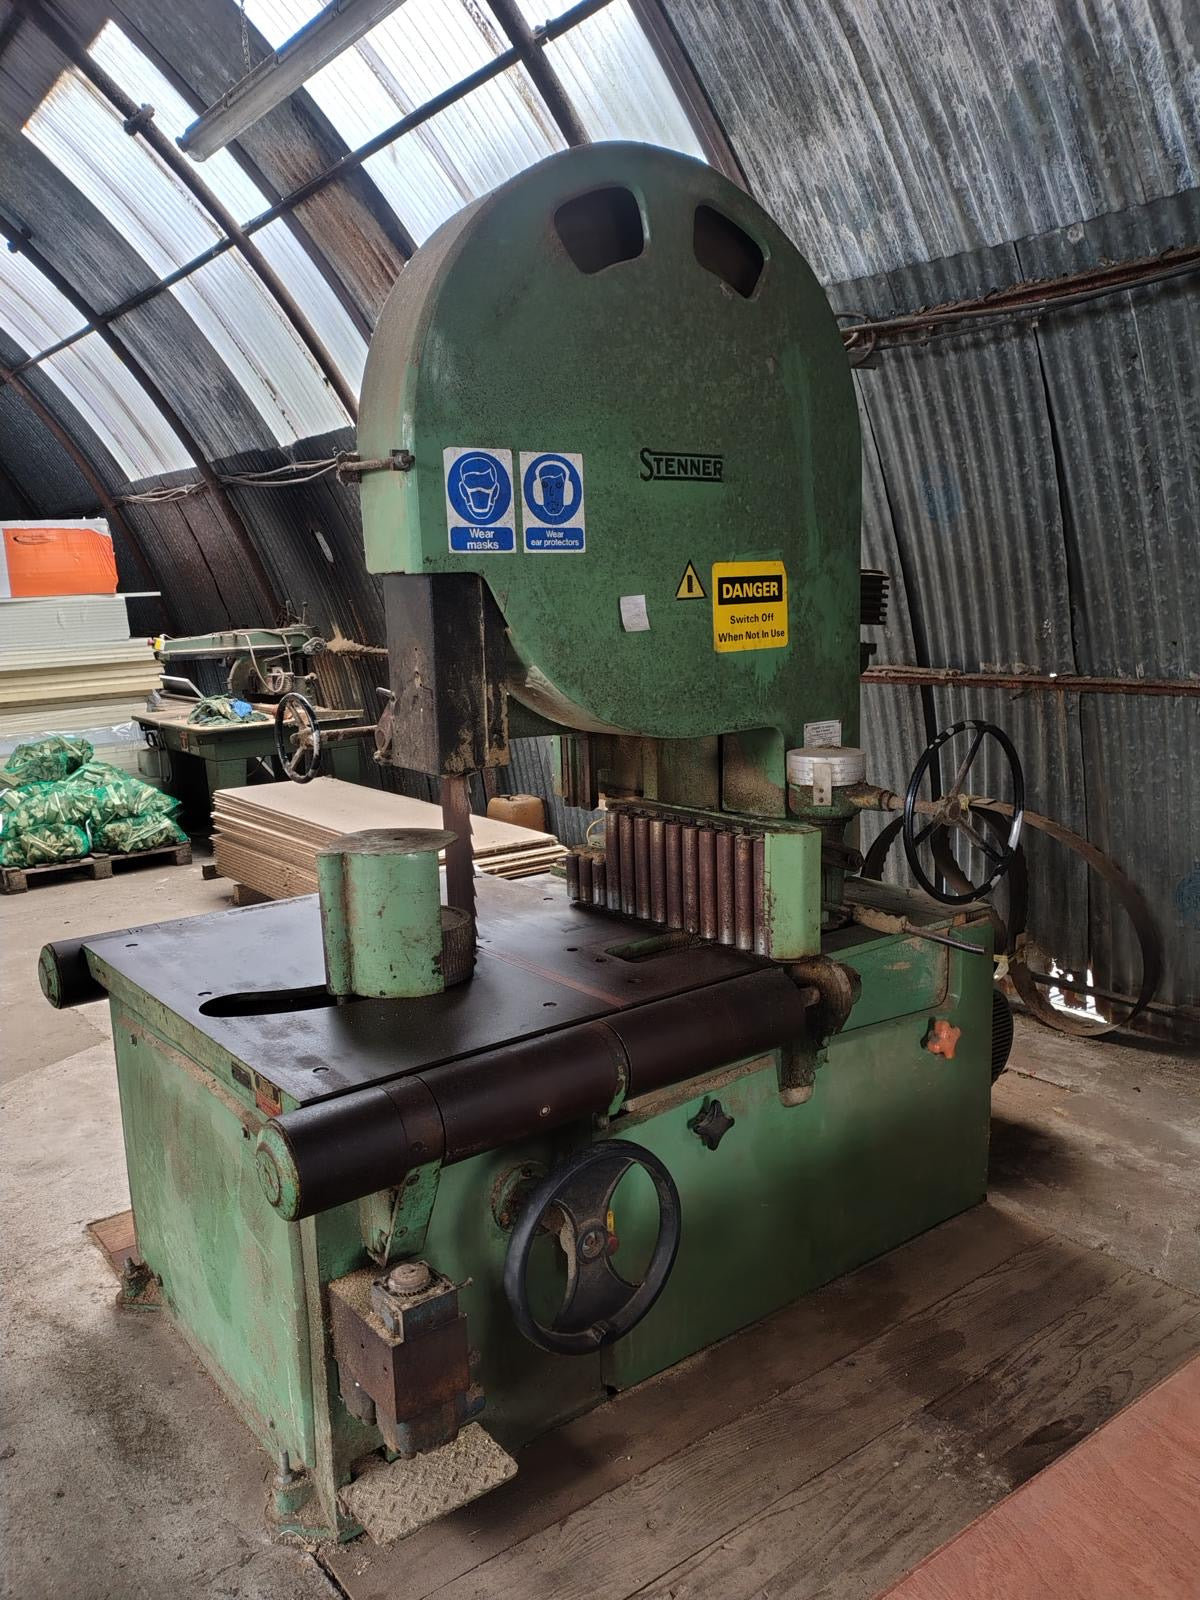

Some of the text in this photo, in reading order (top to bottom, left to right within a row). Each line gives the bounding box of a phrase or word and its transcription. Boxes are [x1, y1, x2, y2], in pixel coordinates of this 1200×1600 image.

[640, 447, 723, 481] STENNER
[469, 528, 495, 539] Wear
[545, 530, 564, 538] Wear
[466, 540, 499, 550] masks
[543, 538, 580, 547] protectors
[722, 582, 779, 599] DANGER
[730, 613, 774, 624] Switch Off
[718, 629, 785, 642] When Not In Use
